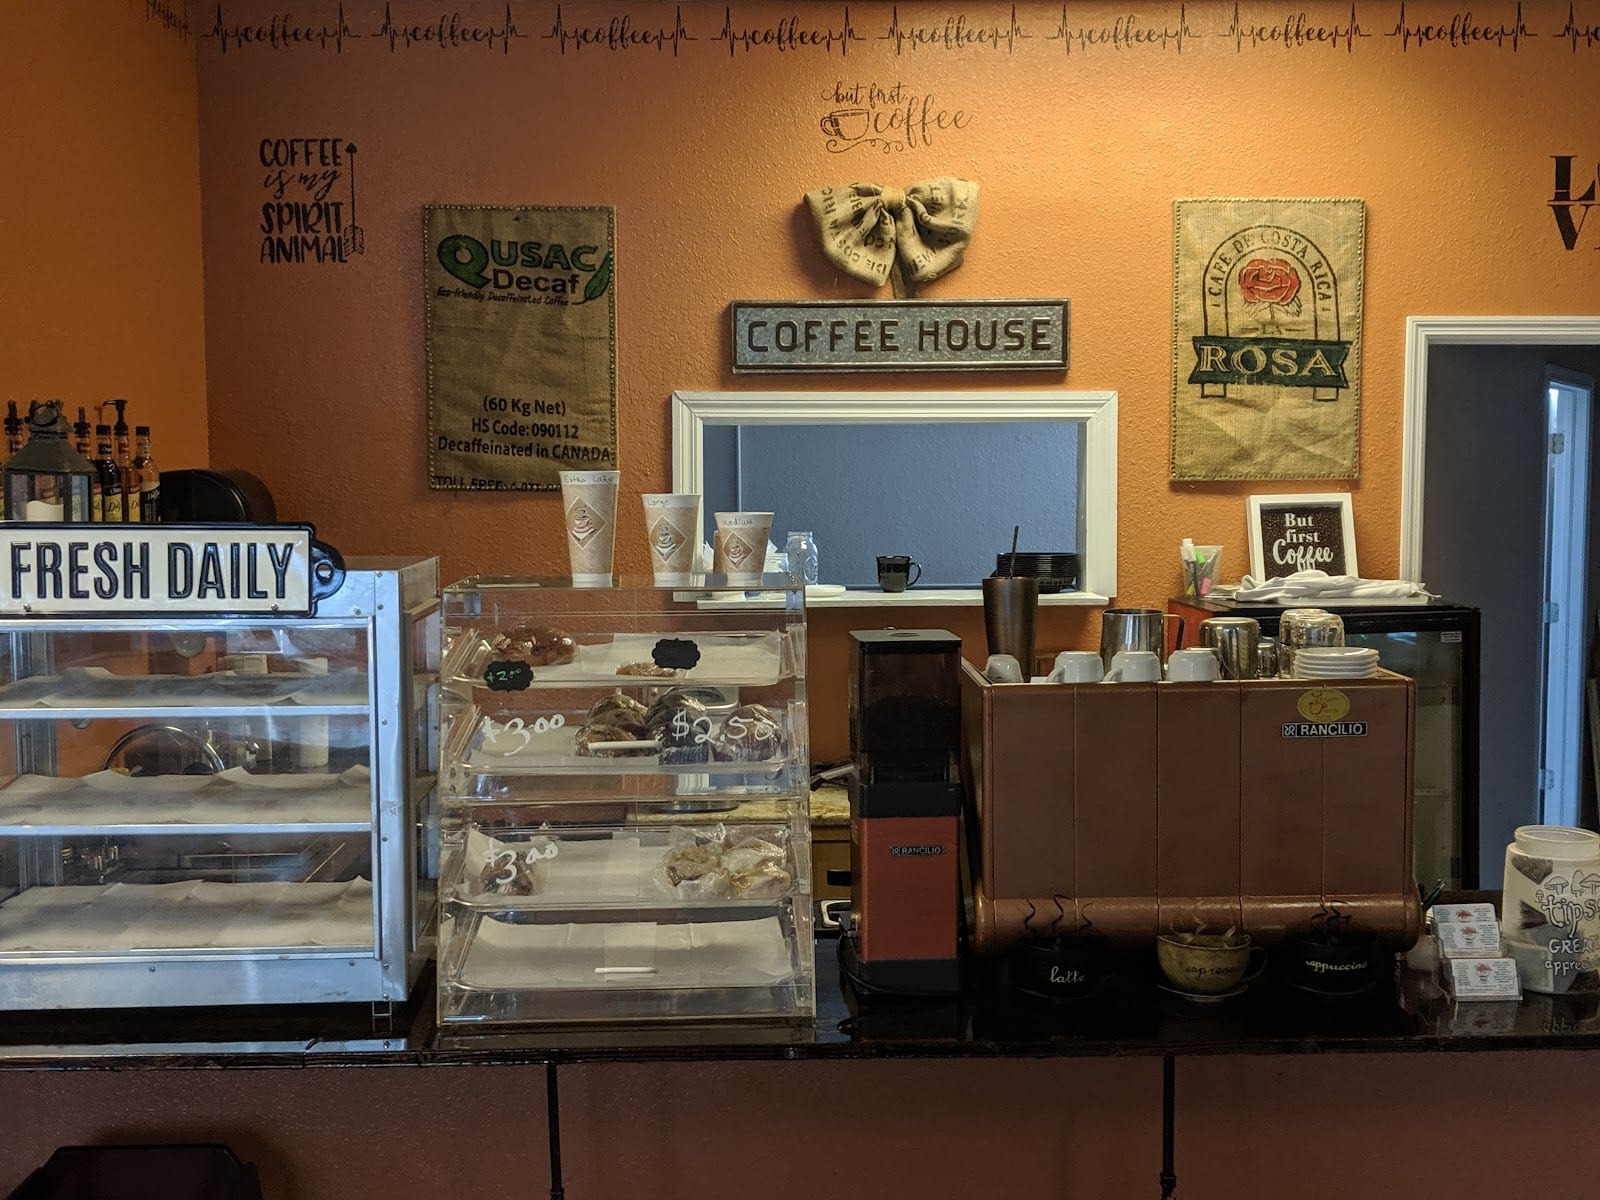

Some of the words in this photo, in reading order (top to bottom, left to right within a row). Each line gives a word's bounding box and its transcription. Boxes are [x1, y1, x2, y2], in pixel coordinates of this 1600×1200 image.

[243, 14, 314, 49] coffee
[413, 13, 485, 47] coffee
[582, 16, 655, 50] coffee
[751, 17, 825, 51] coffee
[919, 15, 991, 50] coffee
[1088, 15, 1161, 49] coffee
[1258, 13, 1330, 46] coffee
[1424, 12, 1498, 47] coffee
[822, 81, 864, 104] but
[869, 81, 908, 109] first
[874, 94, 973, 149] coffee
[260, 138, 343, 167] COFFEE
[264, 169, 295, 199] is
[298, 170, 342, 201] my
[260, 202, 344, 234] SPIRIT
[260, 235, 348, 264] ANIMAL
[437, 234, 599, 289] QUSAC
[1208, 251, 1233, 297] CAFE
[1233, 234, 1253, 255] DE
[1260, 230, 1309, 260] COSTA
[1310, 255, 1332, 301] RICA
[493, 268, 580, 295] Decaf
[545, 295, 569, 307] Coffee
[747, 320, 899, 352] COFFEE
[918, 317, 1051, 351] HOUSE
[1199, 345, 1338, 377] ROSA
[483, 395, 508, 412] (60
[511, 398, 531, 416] Kg
[534, 400, 566, 417] Net)
[472, 418, 489, 433] HS
[492, 420, 530, 437] Code:
[532, 423, 579, 439] 090112
[438, 436, 533, 457] Decaffeinated
[537, 443, 549, 458] in
[552, 444, 611, 462] CANADA
[1284, 513, 1314, 527] But
[1286, 529, 1320, 543] first
[10, 541, 150, 599] FRESH
[168, 541, 294, 599] DAILY
[1273, 538, 1333, 572] Coffee
[672, 707, 774, 744] $2.50
[1300, 723, 1363, 736] RANCILIO
[902, 846, 941, 855] RANCILIO
[1050, 966, 1085, 984] latte
